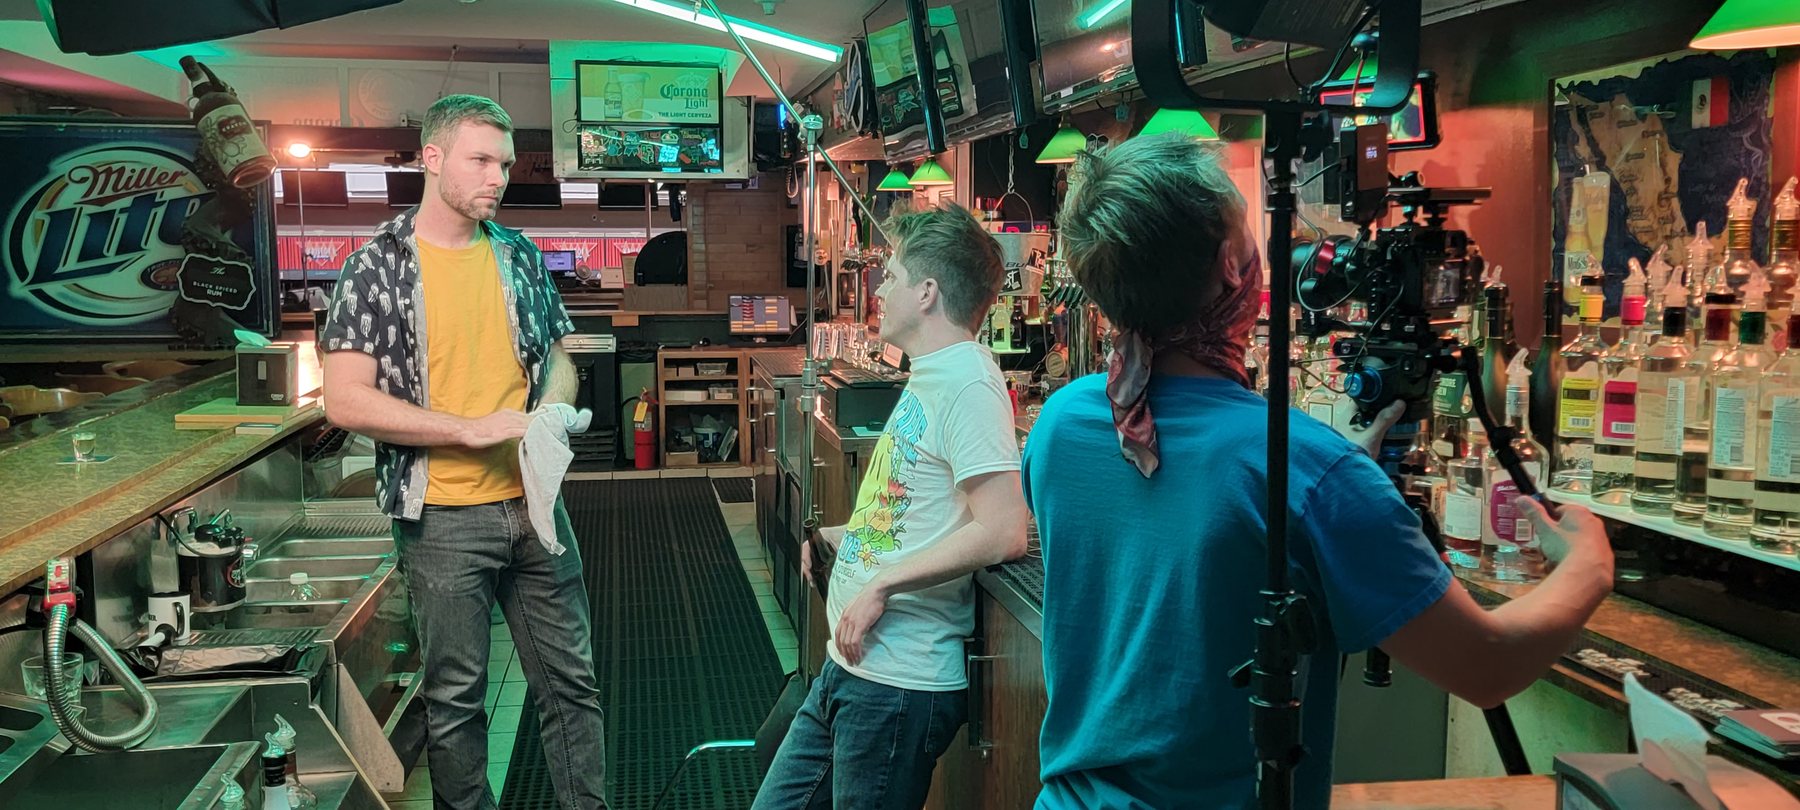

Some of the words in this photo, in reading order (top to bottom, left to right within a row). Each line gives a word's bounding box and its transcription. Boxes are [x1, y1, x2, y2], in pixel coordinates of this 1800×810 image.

[660, 84, 708, 101] Corona
[684, 98, 708, 109] Light
[68, 165, 189, 199] Miller
[192, 281, 213, 290] BLACK
[215, 285, 238, 294] SPICED
